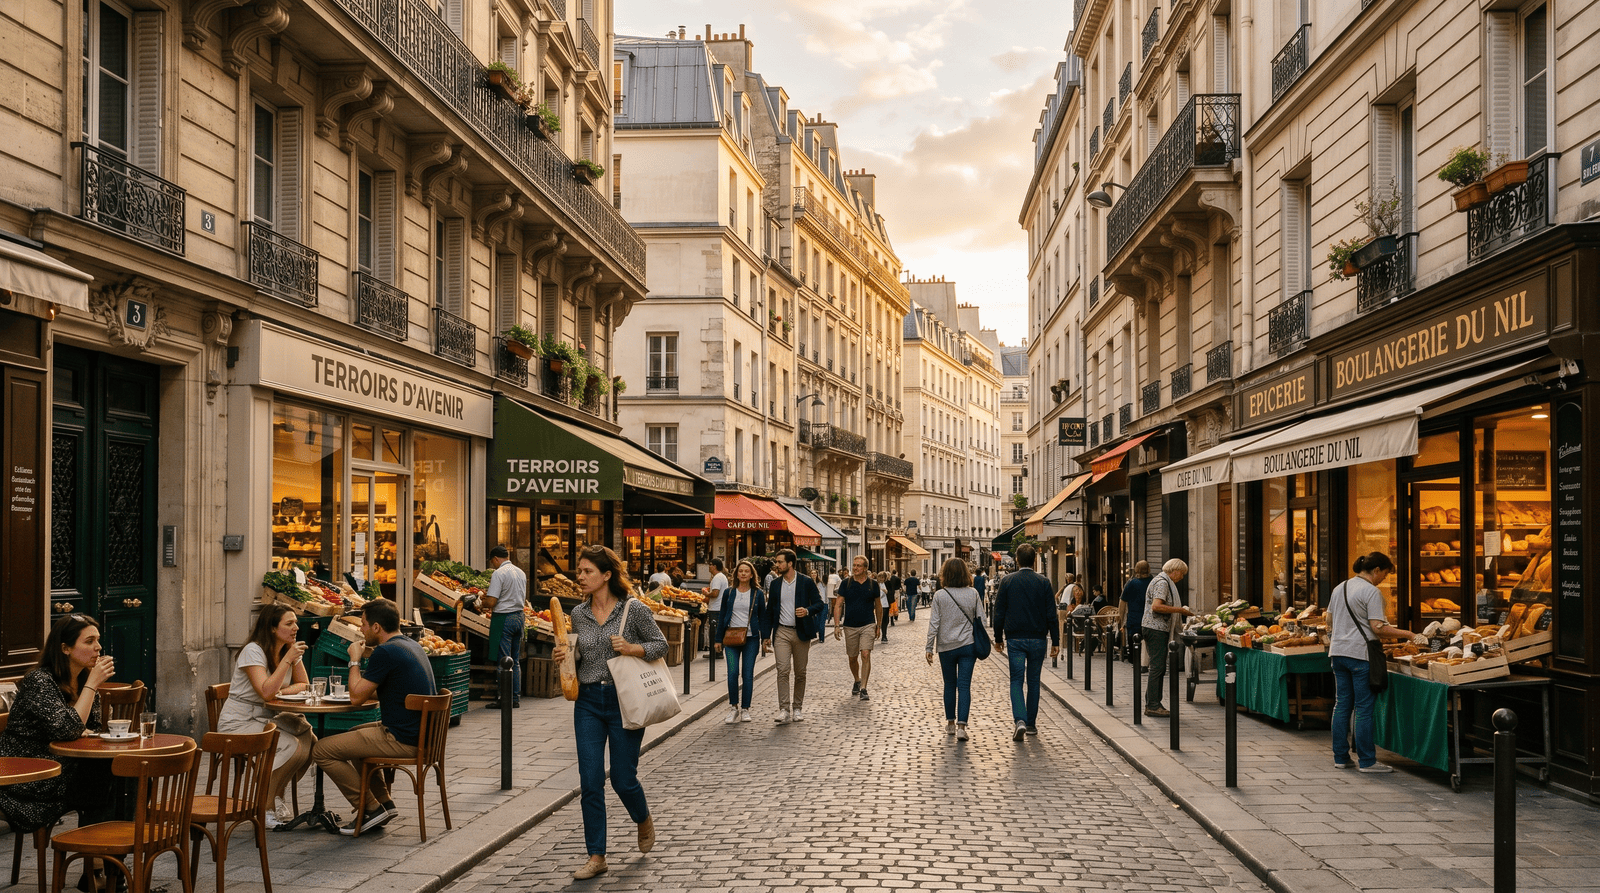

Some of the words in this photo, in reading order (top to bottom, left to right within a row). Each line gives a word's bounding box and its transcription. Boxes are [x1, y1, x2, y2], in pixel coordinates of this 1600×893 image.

[205, 213, 212, 230] 3
[132, 304, 141, 324] 3
[1336, 320, 1449, 389] BOULANGERIE
[1455, 306, 1486, 350] DU
[1493, 290, 1534, 337] NIL
[311, 353, 398, 404] TERROIRS
[402, 380, 464, 421] D'AVENIR
[1249, 375, 1306, 418] EPICERIE
[1264, 444, 1325, 475] BOULANGERIE
[1327, 440, 1342, 463] DU
[1344, 436, 1363, 460] NIL
[506, 459, 600, 474] TERROIRS
[1201, 465, 1213, 483] NIL
[507, 478, 600, 494] D'AVENIR
[727, 521, 746, 529] CAFÉ
